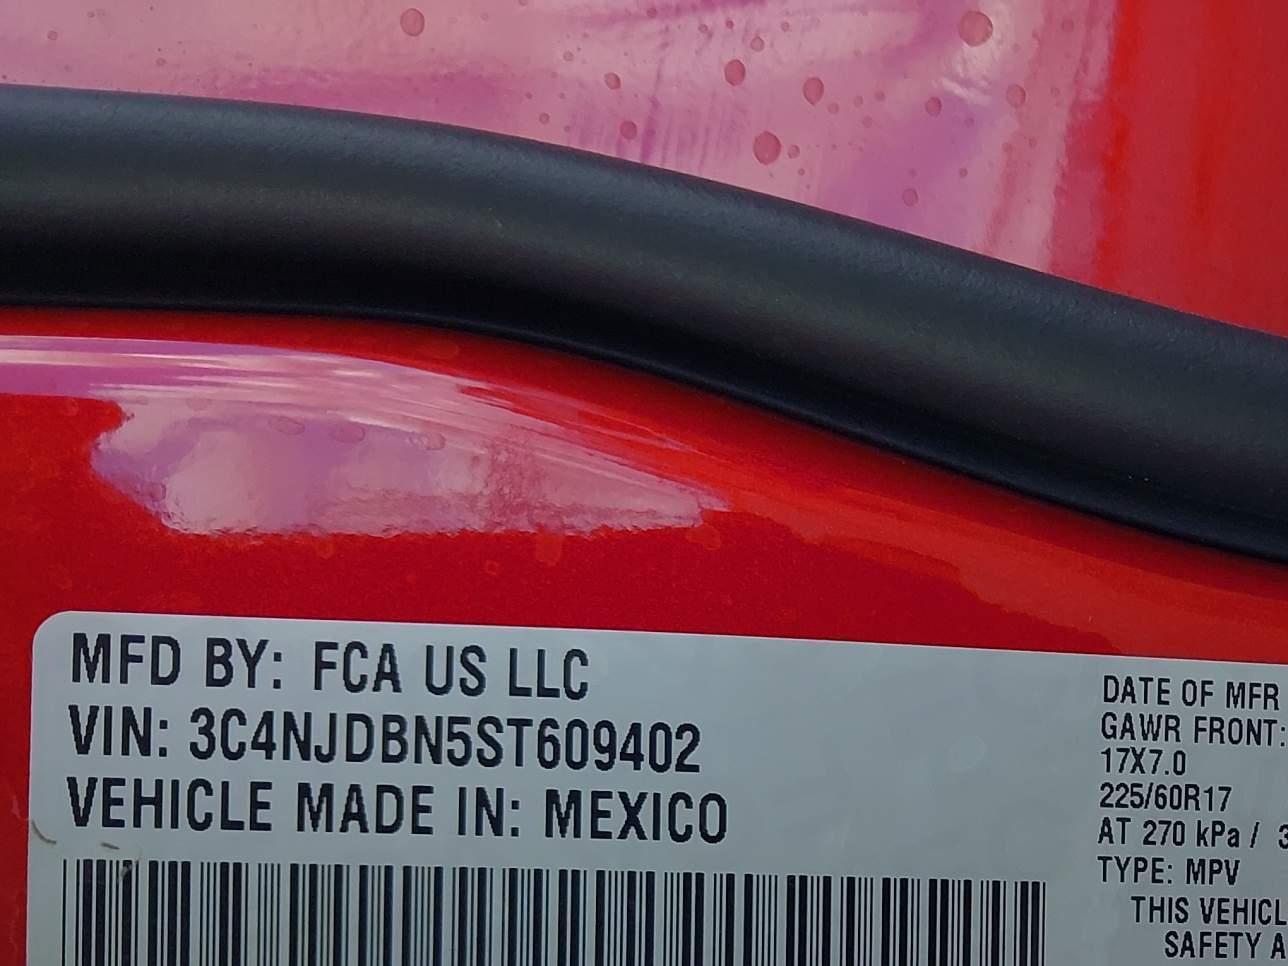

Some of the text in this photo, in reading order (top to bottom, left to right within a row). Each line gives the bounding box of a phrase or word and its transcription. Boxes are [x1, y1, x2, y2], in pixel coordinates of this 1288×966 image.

[71, 632, 589, 701] MFD BY: FCA US LLC
[1103, 674, 1171, 706] DATE
[1181, 679, 1214, 708] OF
[1225, 681, 1280, 711] MFR
[67, 704, 701, 774] VIN: 3C4NJDBN5ST609402
[1101, 711, 1181, 743] GAWR
[1194, 715, 1286, 747] FRONT:
[1100, 746, 1186, 776] 17X7.0
[66, 776, 727, 844] VEHICLE MADE IN: MEXICO
[1099, 781, 1232, 812] 225/60R17
[1097, 816, 1132, 845] AT
[1142, 819, 1186, 847] 270
[1196, 819, 1240, 848] kPa
[1249, 821, 1260, 849] /
[1097, 855, 1241, 886] TYPE: MPV
[1130, 895, 1189, 924] THIS
[1164, 930, 1262, 959] SAFETY
